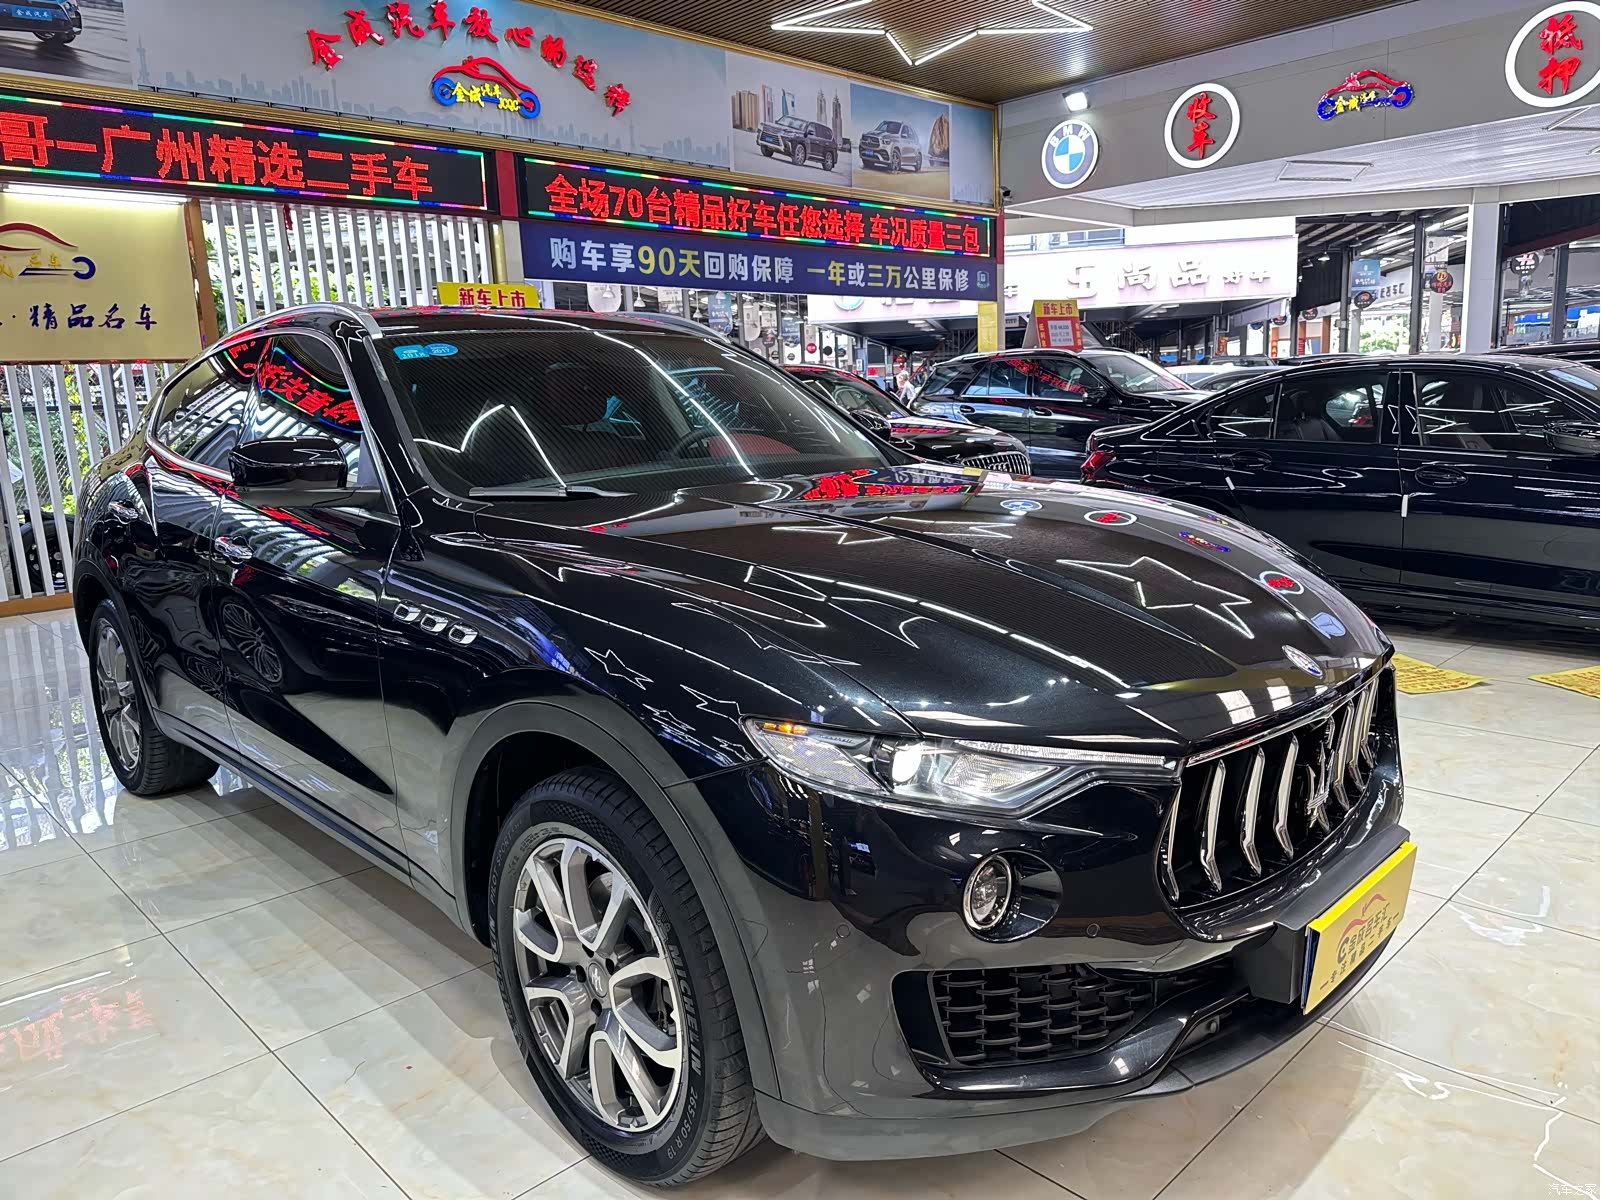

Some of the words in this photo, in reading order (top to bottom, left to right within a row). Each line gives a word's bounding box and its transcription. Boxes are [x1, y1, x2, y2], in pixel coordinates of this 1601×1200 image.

[1050, 124, 1091, 148] BMW
[545, 173, 865, 244] 全场70台精品好车任您选择
[870, 213, 980, 253] 车况质量三包
[550, 237, 794, 285] 购车享90天回购保障
[807, 260, 969, 292] 一年或三万公里保修
[458, 287, 526, 308] 新车上市
[1042, 302, 1073, 316] 新车上市
[667, 944, 702, 1077] MICHELIN
[679, 1086, 699, 1140] 265/50
[675, 1138, 685, 1150] R
